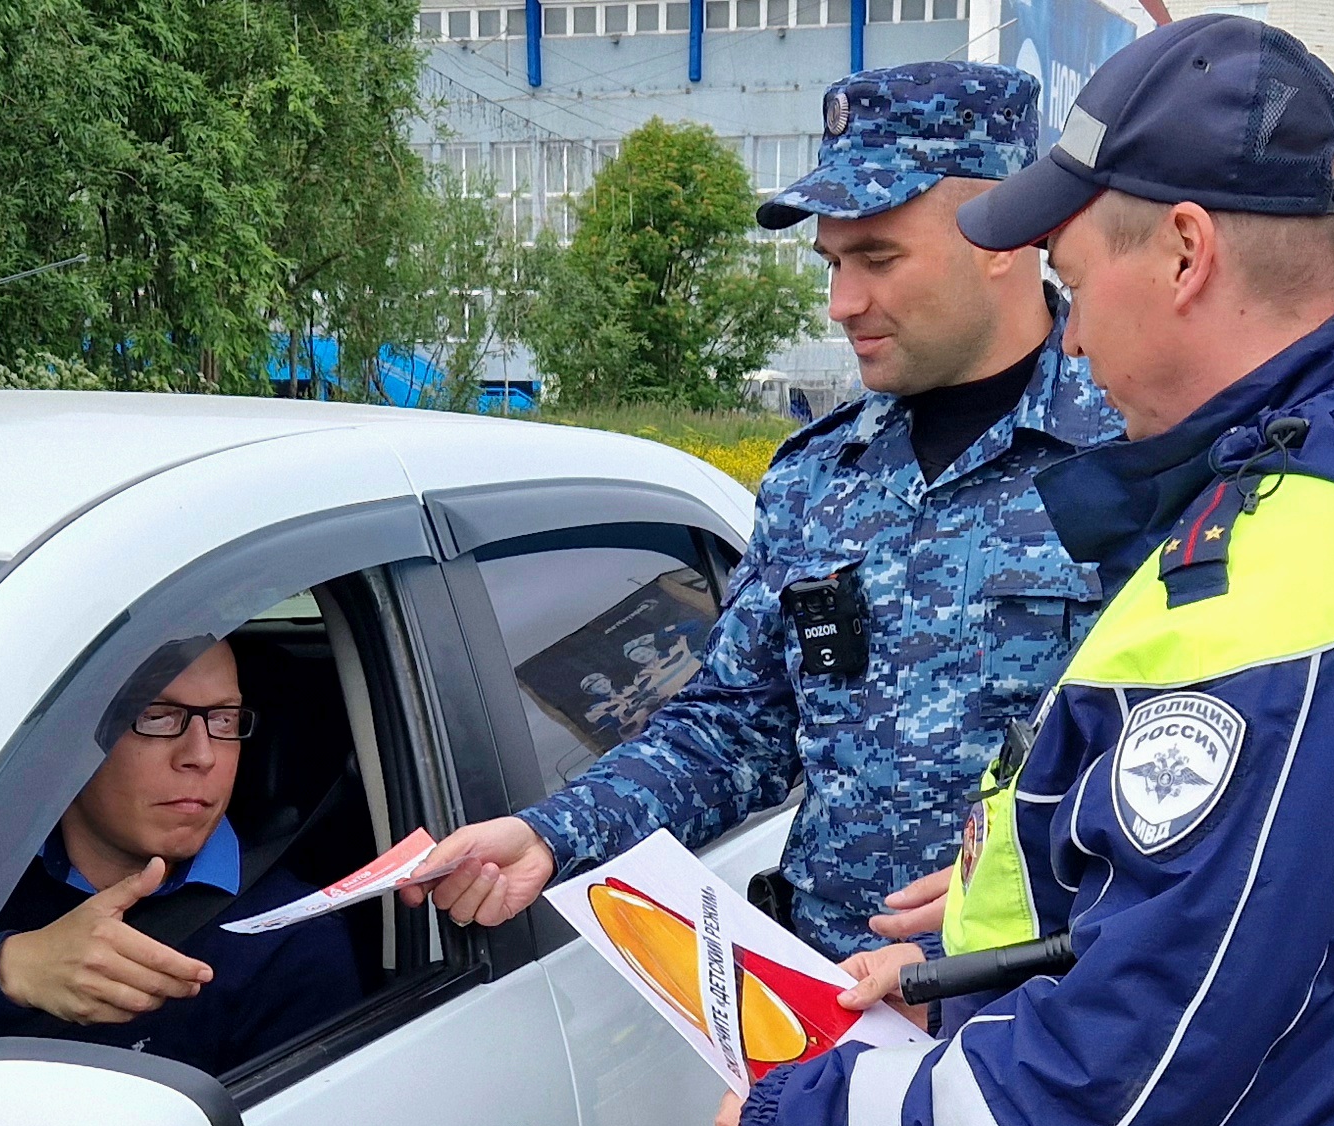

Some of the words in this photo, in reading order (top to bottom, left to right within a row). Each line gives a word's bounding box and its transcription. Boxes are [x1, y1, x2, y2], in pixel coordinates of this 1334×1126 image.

[804, 623, 838, 639] DOZOR
[1136, 700, 1234, 739] ПОЛИЦИЯ
[1134, 723, 1218, 762] РОССИЯ
[1132, 815, 1171, 845] МВД
[700, 885, 720, 940] РЕЖИМ»
[705, 934, 731, 1008] «ДЕТСКИЙ
